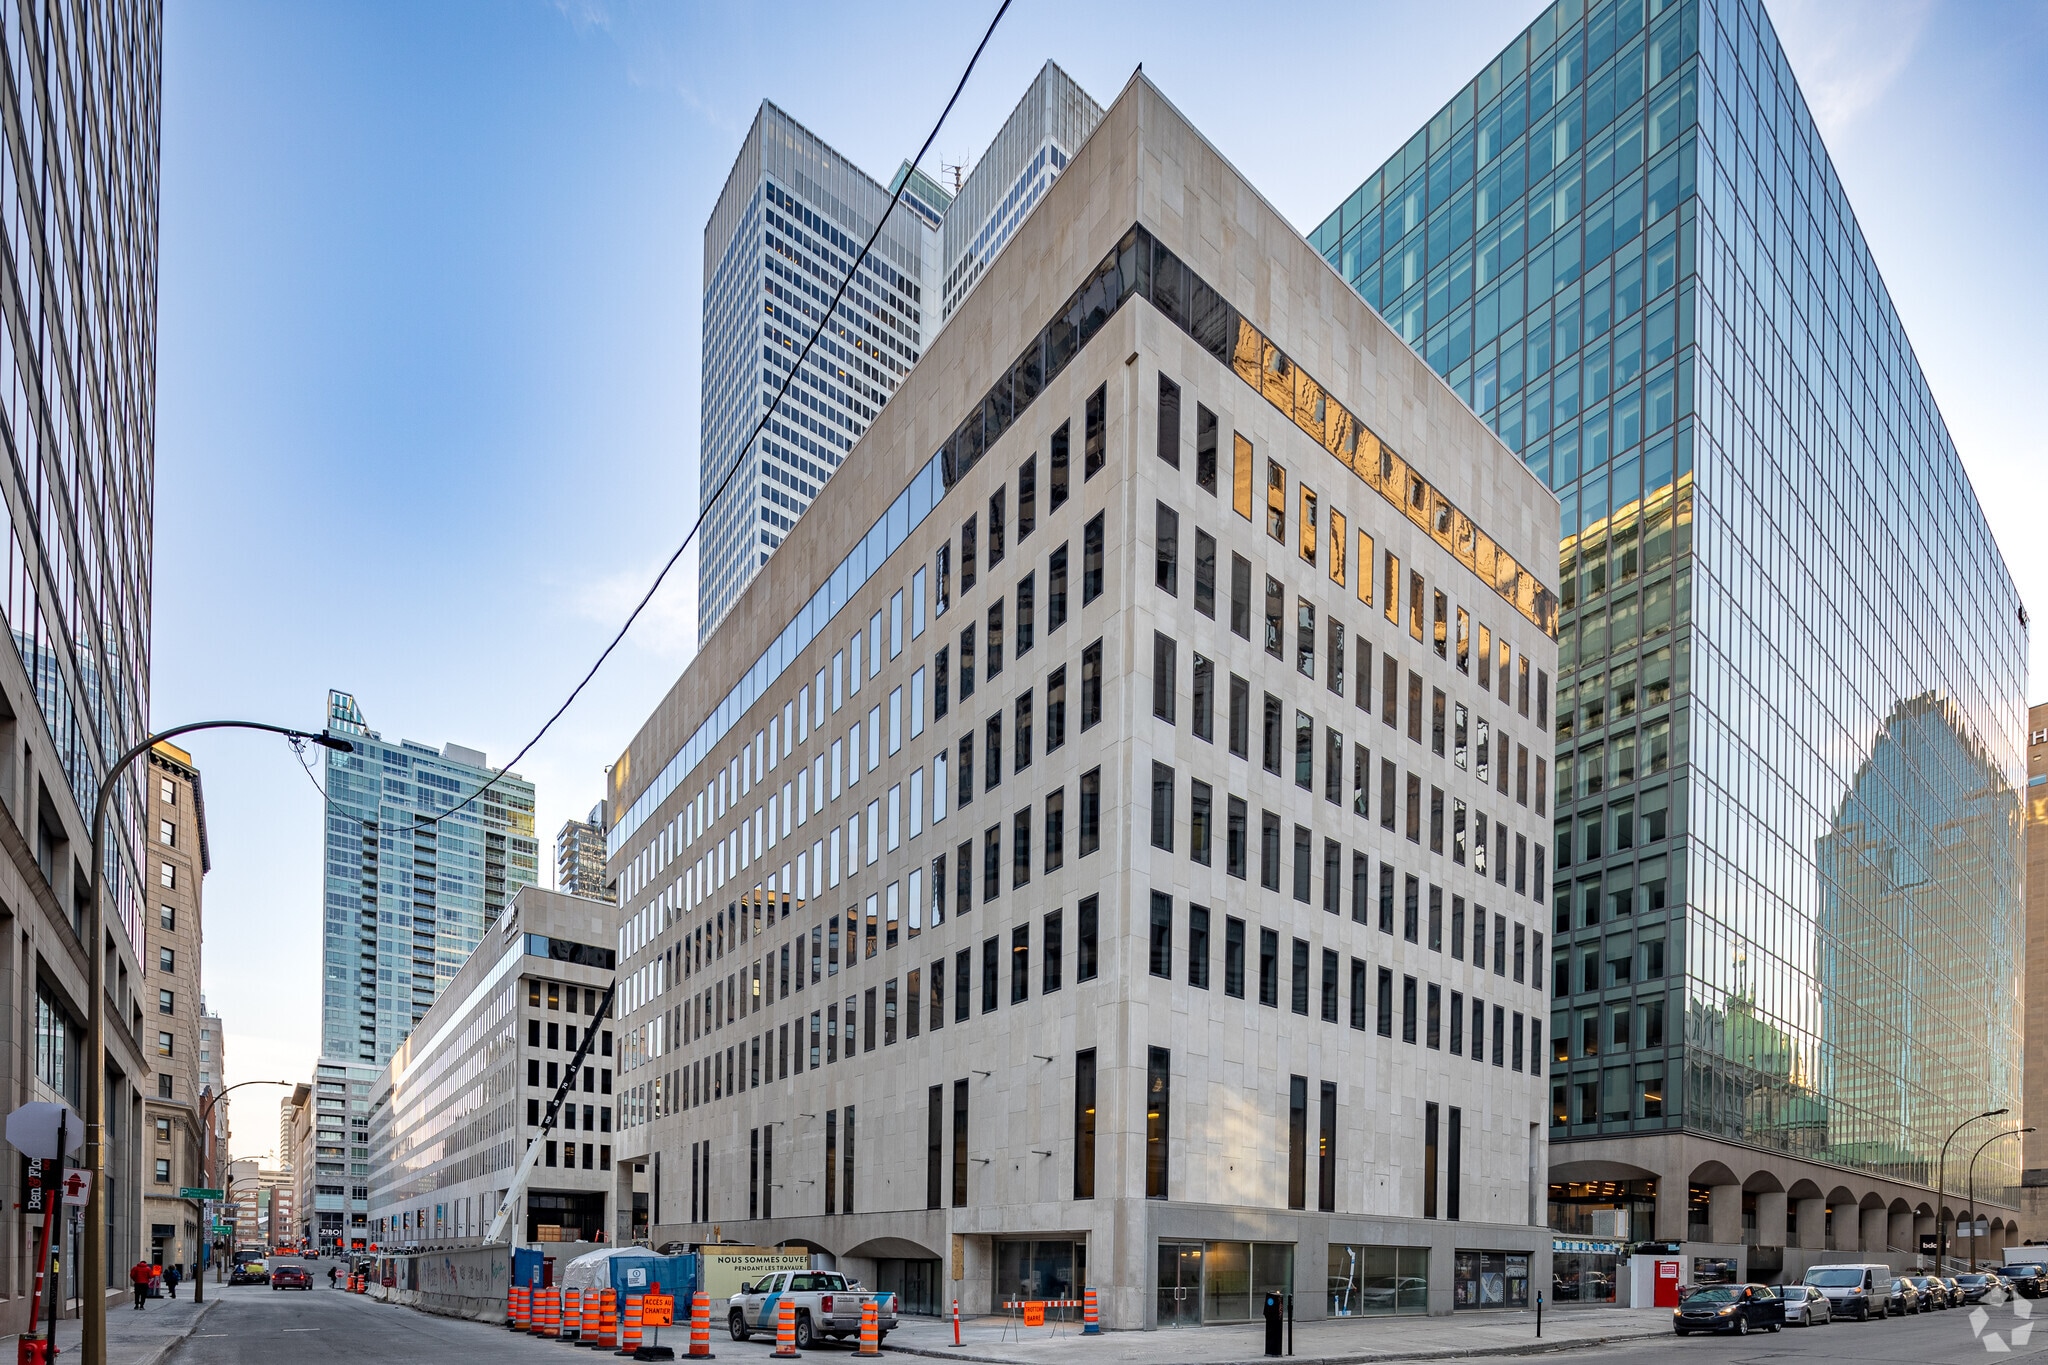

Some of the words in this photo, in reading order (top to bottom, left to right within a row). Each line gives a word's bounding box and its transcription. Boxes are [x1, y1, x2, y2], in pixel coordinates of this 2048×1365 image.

[717, 1256, 743, 1264] NOUS
[744, 1256, 780, 1264] SOMMES
[645, 1298, 664, 1306] ACCÈS
